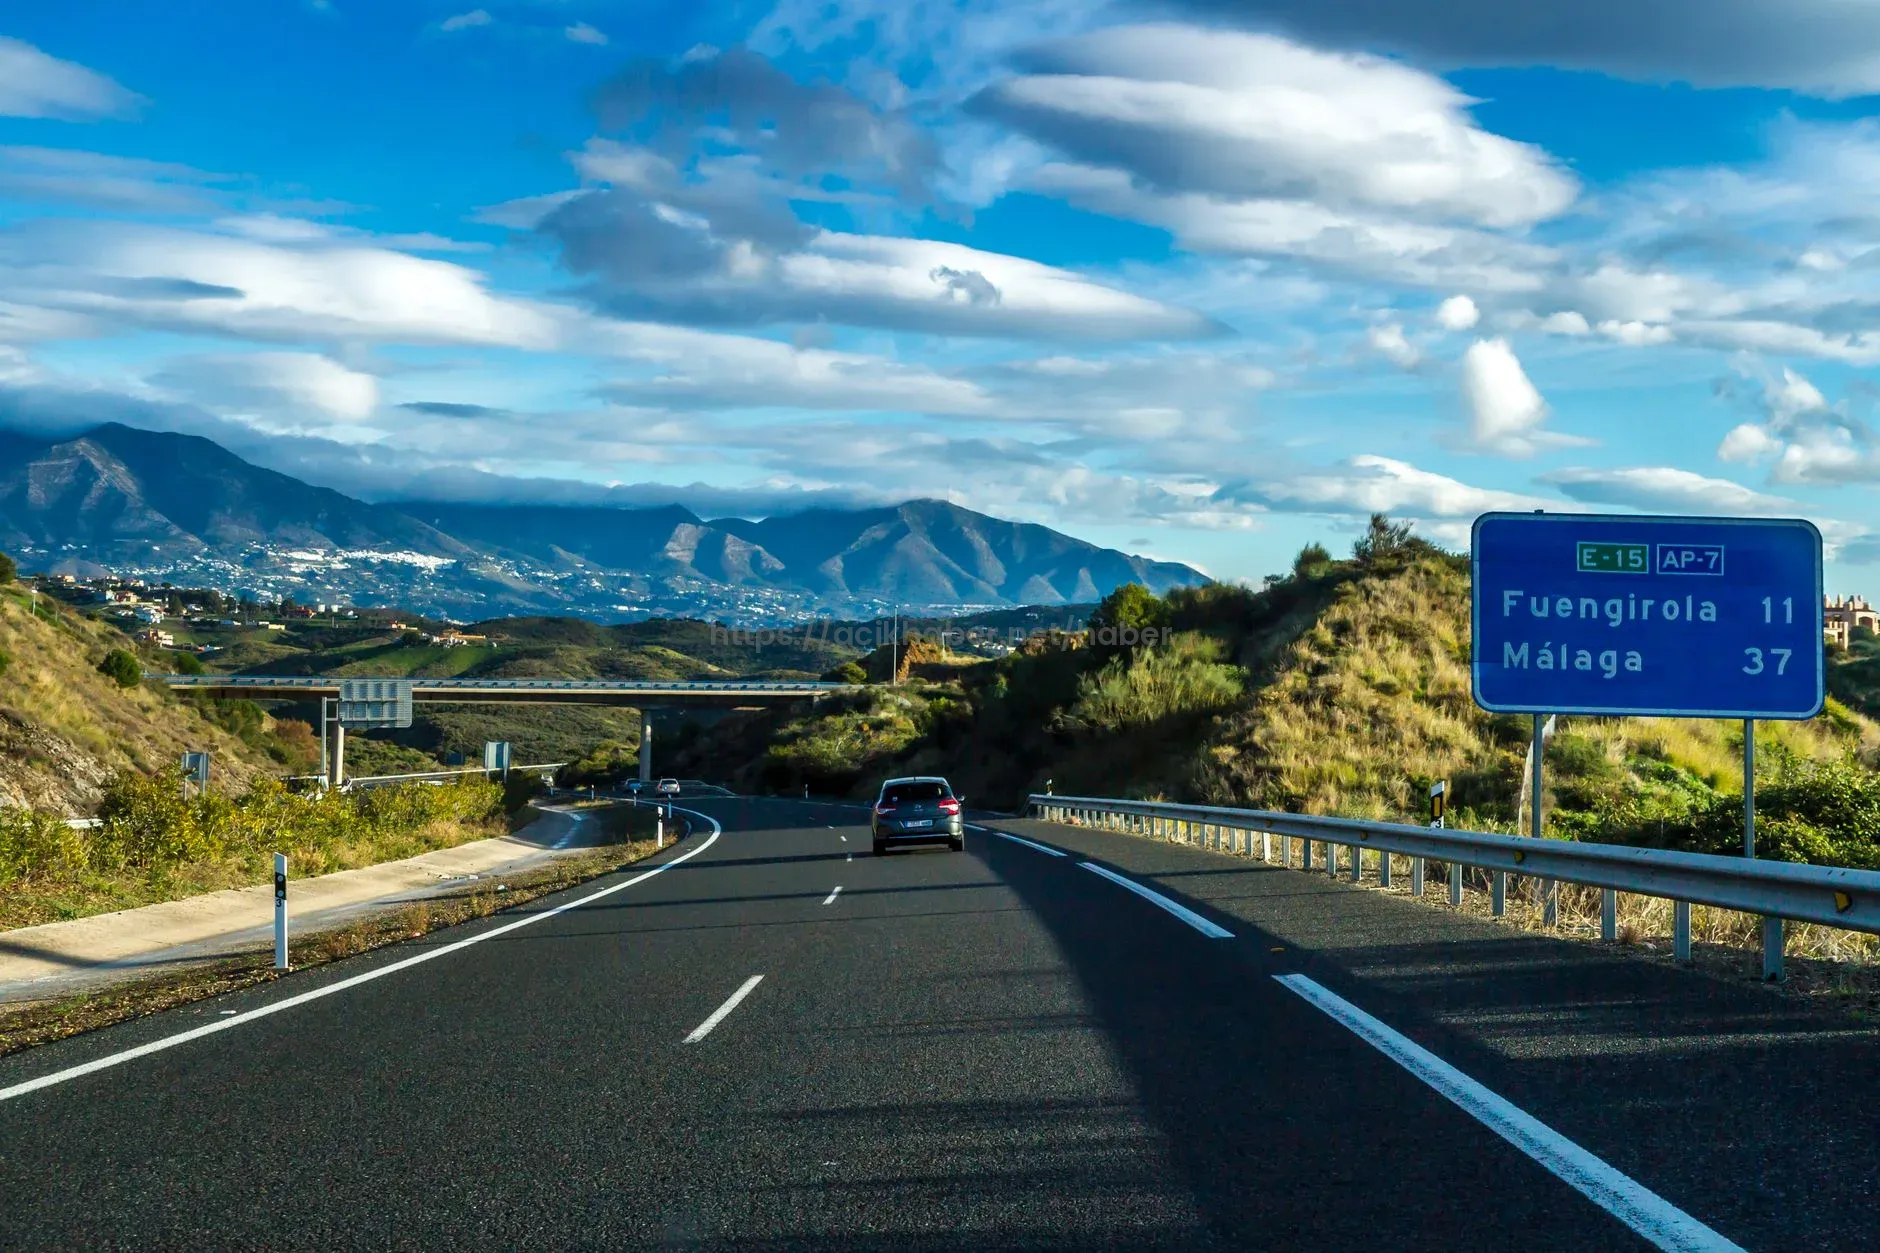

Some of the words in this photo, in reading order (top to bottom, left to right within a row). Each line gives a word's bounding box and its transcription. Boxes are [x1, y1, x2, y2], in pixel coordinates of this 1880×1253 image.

[1582, 548, 1643, 568] E-15
[1662, 550, 1719, 569] AP-7
[1503, 590, 1717, 627] Fuengirola
[1761, 597, 1793, 624] 11
[1503, 641, 1642, 679] Málaga
[1742, 647, 1792, 676] 37
[276, 899, 282, 908] 3
